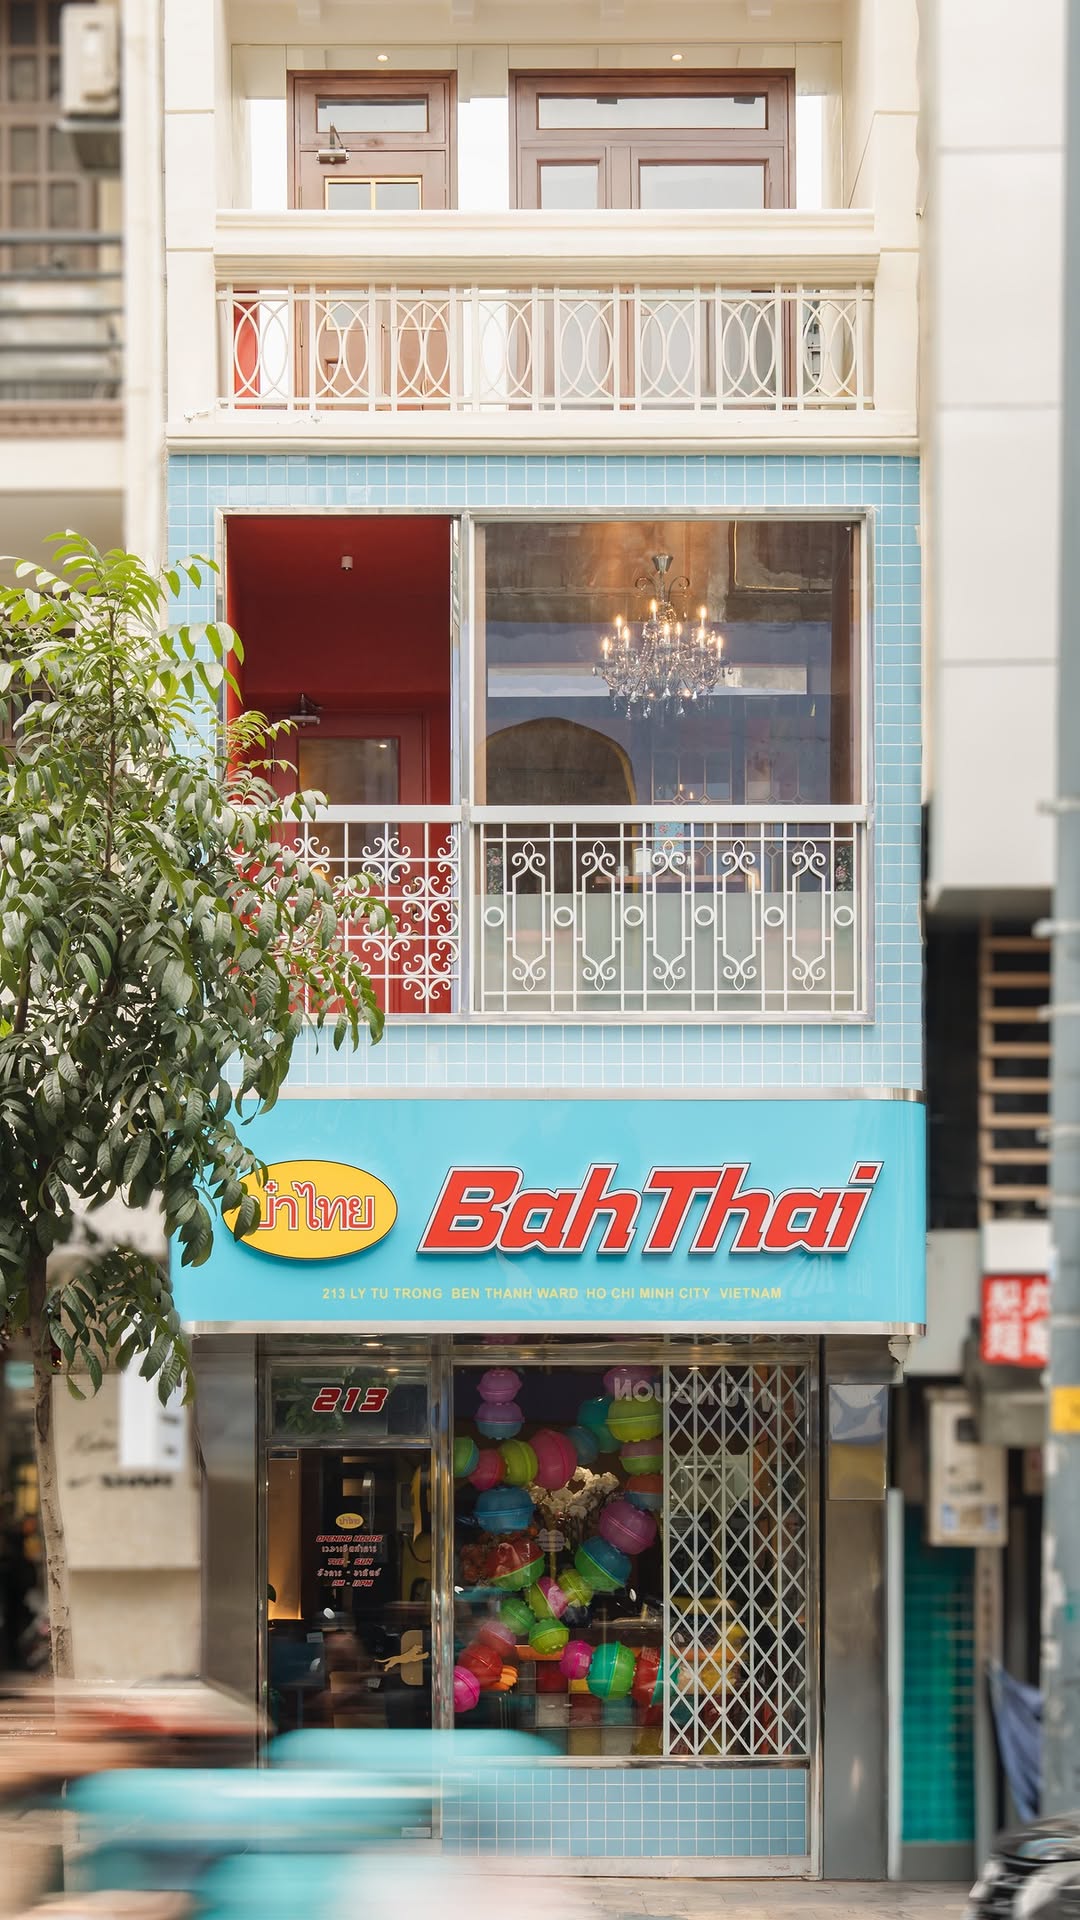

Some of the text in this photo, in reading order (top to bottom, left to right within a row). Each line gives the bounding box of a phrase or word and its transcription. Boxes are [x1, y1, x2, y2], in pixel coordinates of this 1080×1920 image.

[321, 1287, 782, 1300] 213 LY TU TRONG BEN THANH WARD HO CHI MINH CITY VIETNAM
[312, 1387, 388, 1413] 213
[316, 1535, 383, 1543] OPENING HOURS
[327, 1558, 345, 1566] TUE
[354, 1558, 374, 1566] SUN
